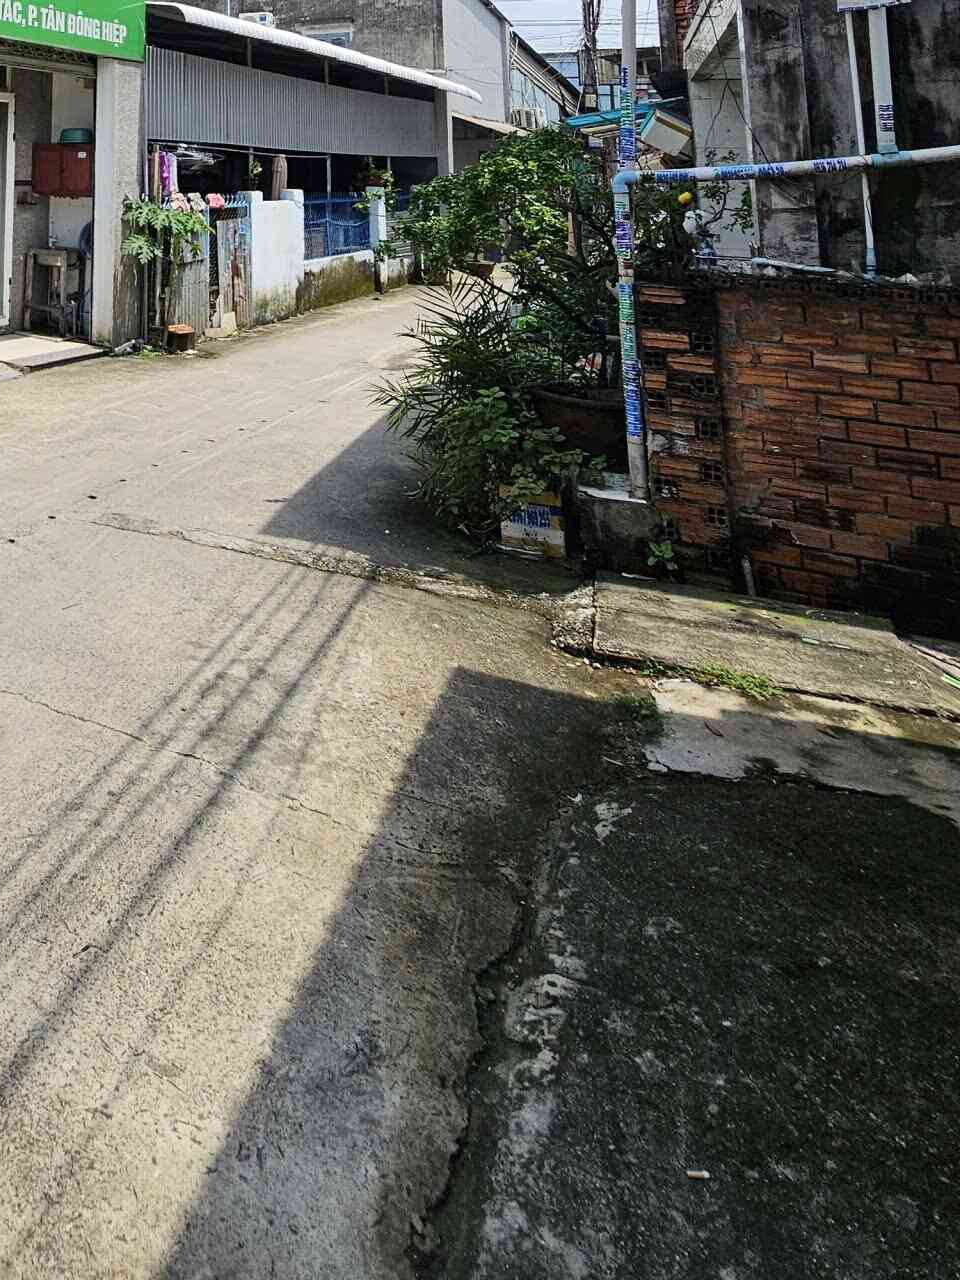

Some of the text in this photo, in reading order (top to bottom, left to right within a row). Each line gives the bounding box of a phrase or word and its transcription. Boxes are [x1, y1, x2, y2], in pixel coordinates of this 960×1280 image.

[27, 4, 39, 27] P.
[41, 4, 66, 32] TÂN
[68, 11, 101, 40] ĐÔNG
[101, 19, 128, 48] HIỆP
